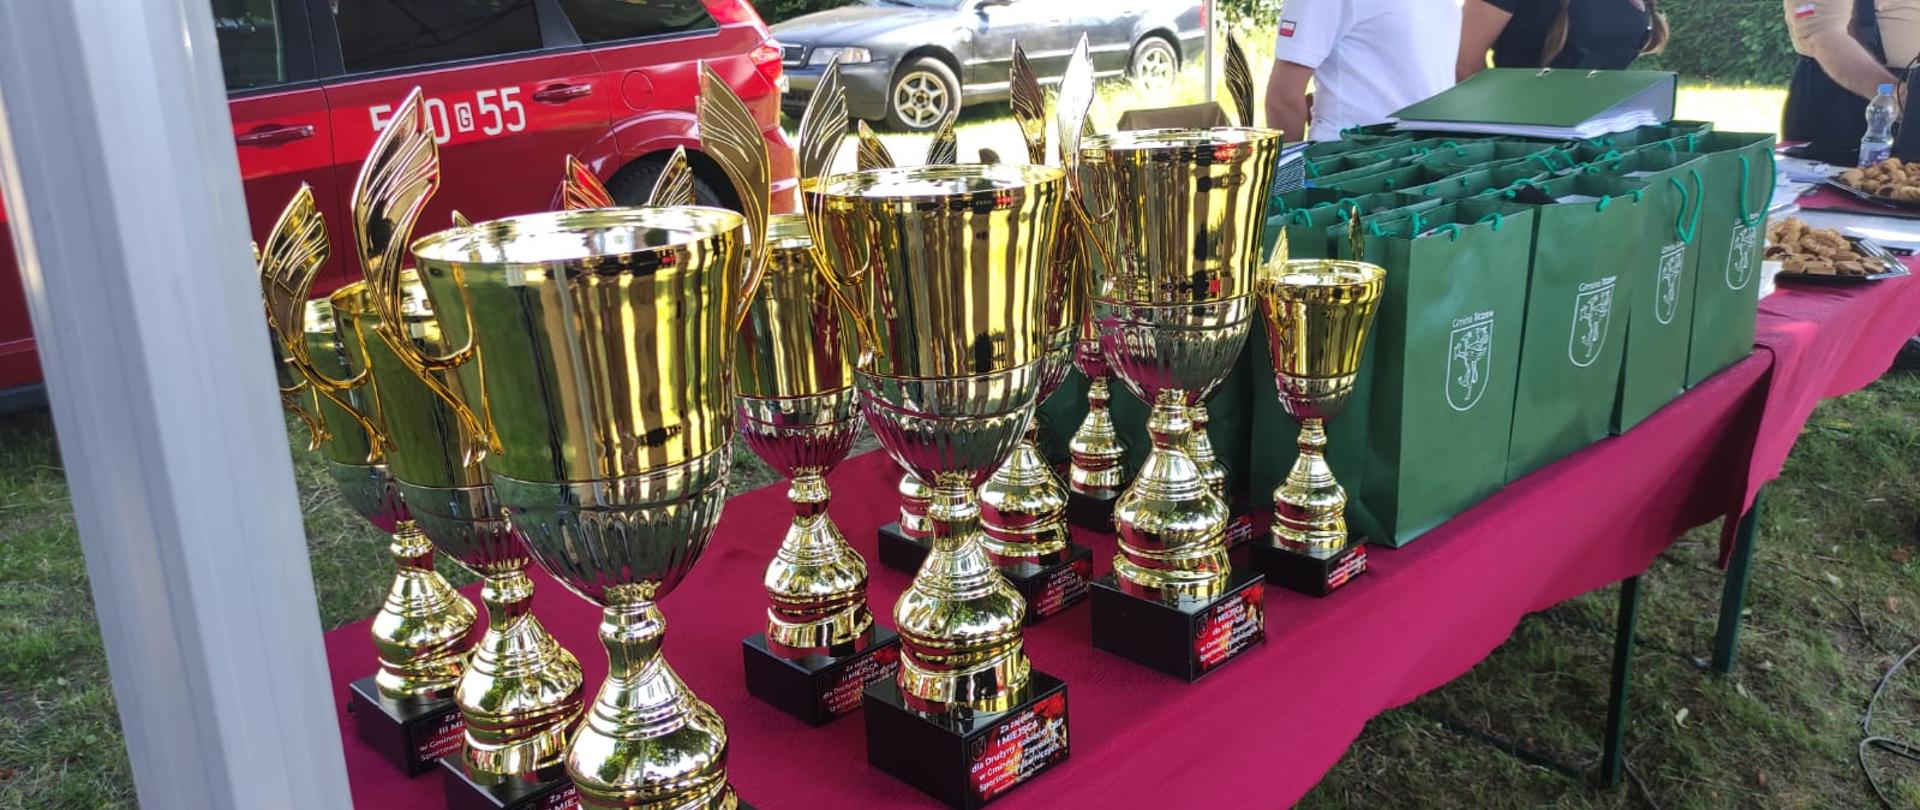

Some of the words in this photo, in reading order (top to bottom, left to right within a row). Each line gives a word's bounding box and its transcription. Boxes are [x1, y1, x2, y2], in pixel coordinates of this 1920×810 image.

[369, 98, 451, 144] 50
[457, 105, 472, 129] G
[476, 86, 526, 136] 55
[439, 725, 449, 734] III
[1000, 725, 1009, 734] Za
[1002, 720, 1038, 744] MIEJSCA
[971, 761, 984, 773] dla
